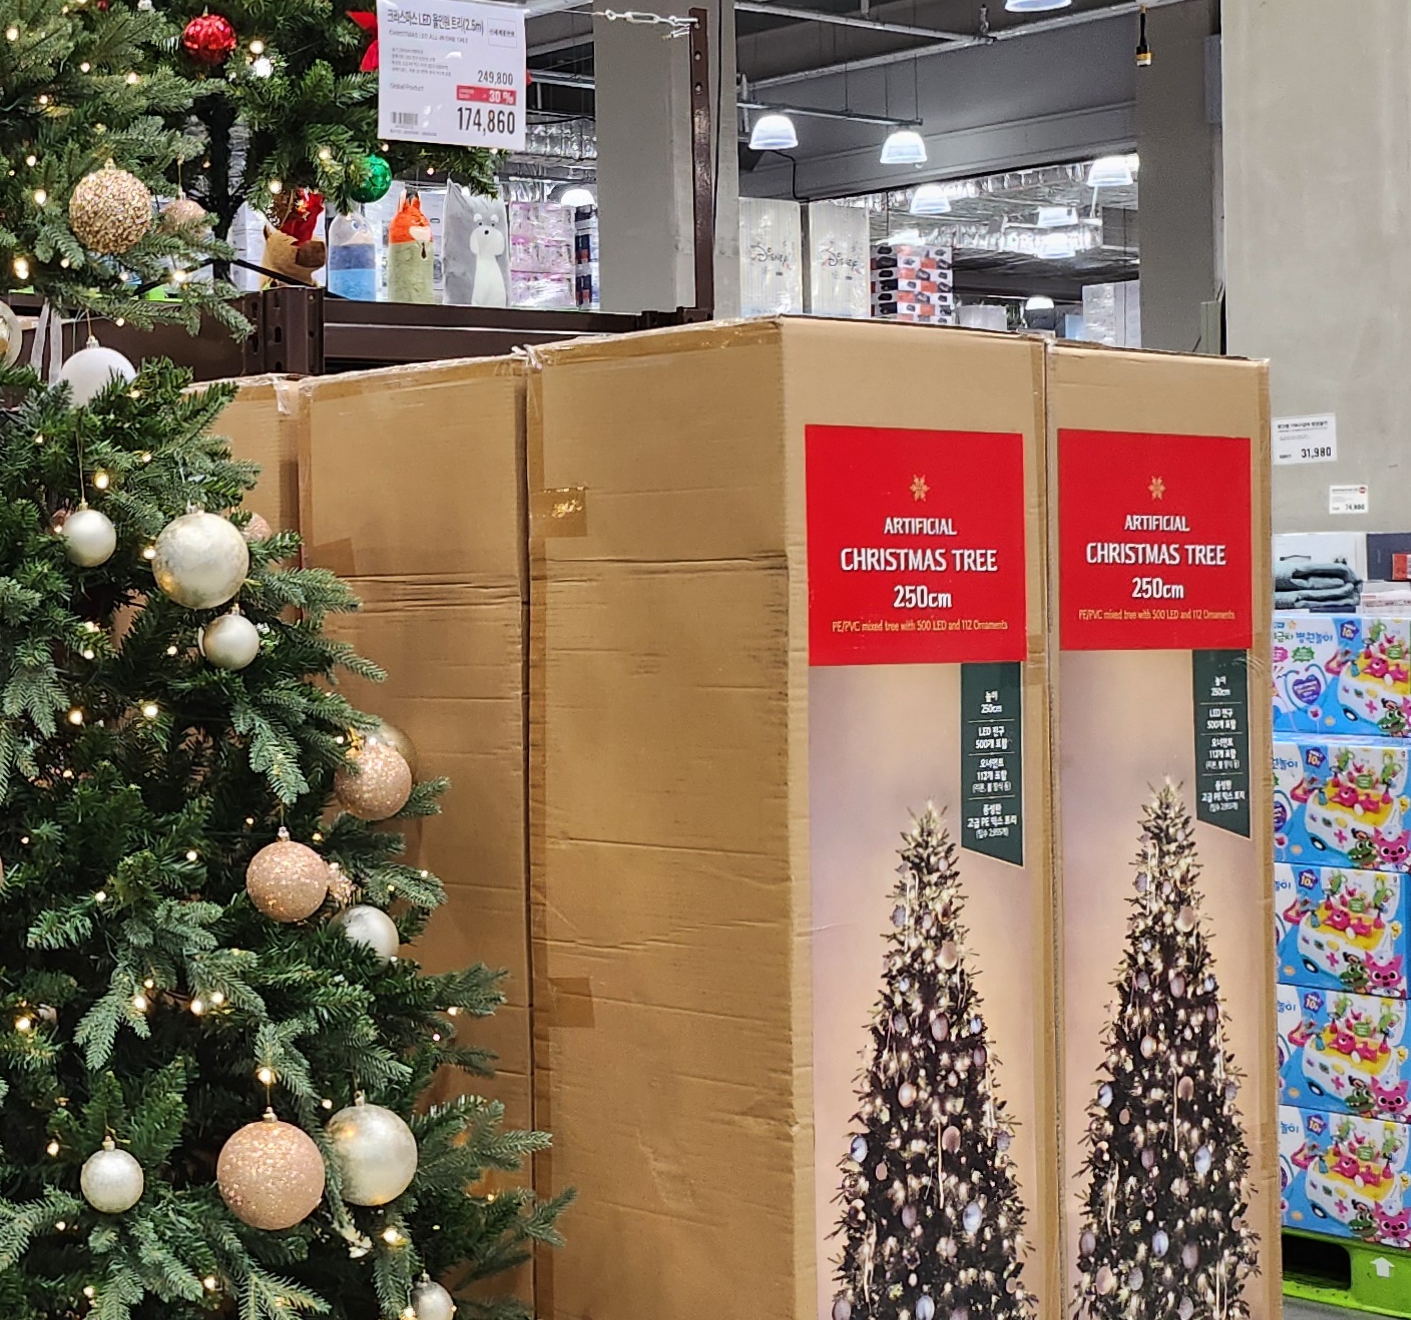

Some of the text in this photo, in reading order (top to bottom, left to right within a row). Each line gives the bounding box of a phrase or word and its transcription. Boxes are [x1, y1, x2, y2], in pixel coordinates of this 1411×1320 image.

[387, 9, 418, 26] 크리스마스
[419, 12, 431, 26] LED
[433, 13, 451, 30] 올인원
[478, 70, 513, 86] 249,800
[457, 107, 515, 136] 174,860
[1301, 446, 1332, 459] 31,980
[884, 517, 957, 536] ARTIFICIAL
[1124, 515, 1190, 532] ARTIFICIAL
[840, 548, 998, 572] CHRISTMAS TREE
[1086, 543, 1226, 566] CHRISTMAS TREE
[893, 585, 952, 608] 250cm
[1132, 577, 1184, 599] 250cm
[1079, 609, 1102, 621] PE/PVC
[1124, 609, 1137, 619] tree
[1152, 609, 1165, 619] 500
[1166, 609, 1178, 619] LED
[1180, 609, 1191, 619] and
[832, 621, 860, 632] PE/PVC
[884, 620, 899, 631] tree
[917, 620, 931, 631] 500
[933, 620, 946, 630] LED
[948, 619, 960, 630] and
[979, 726, 992, 737] LED
[981, 816, 990, 827] PE
